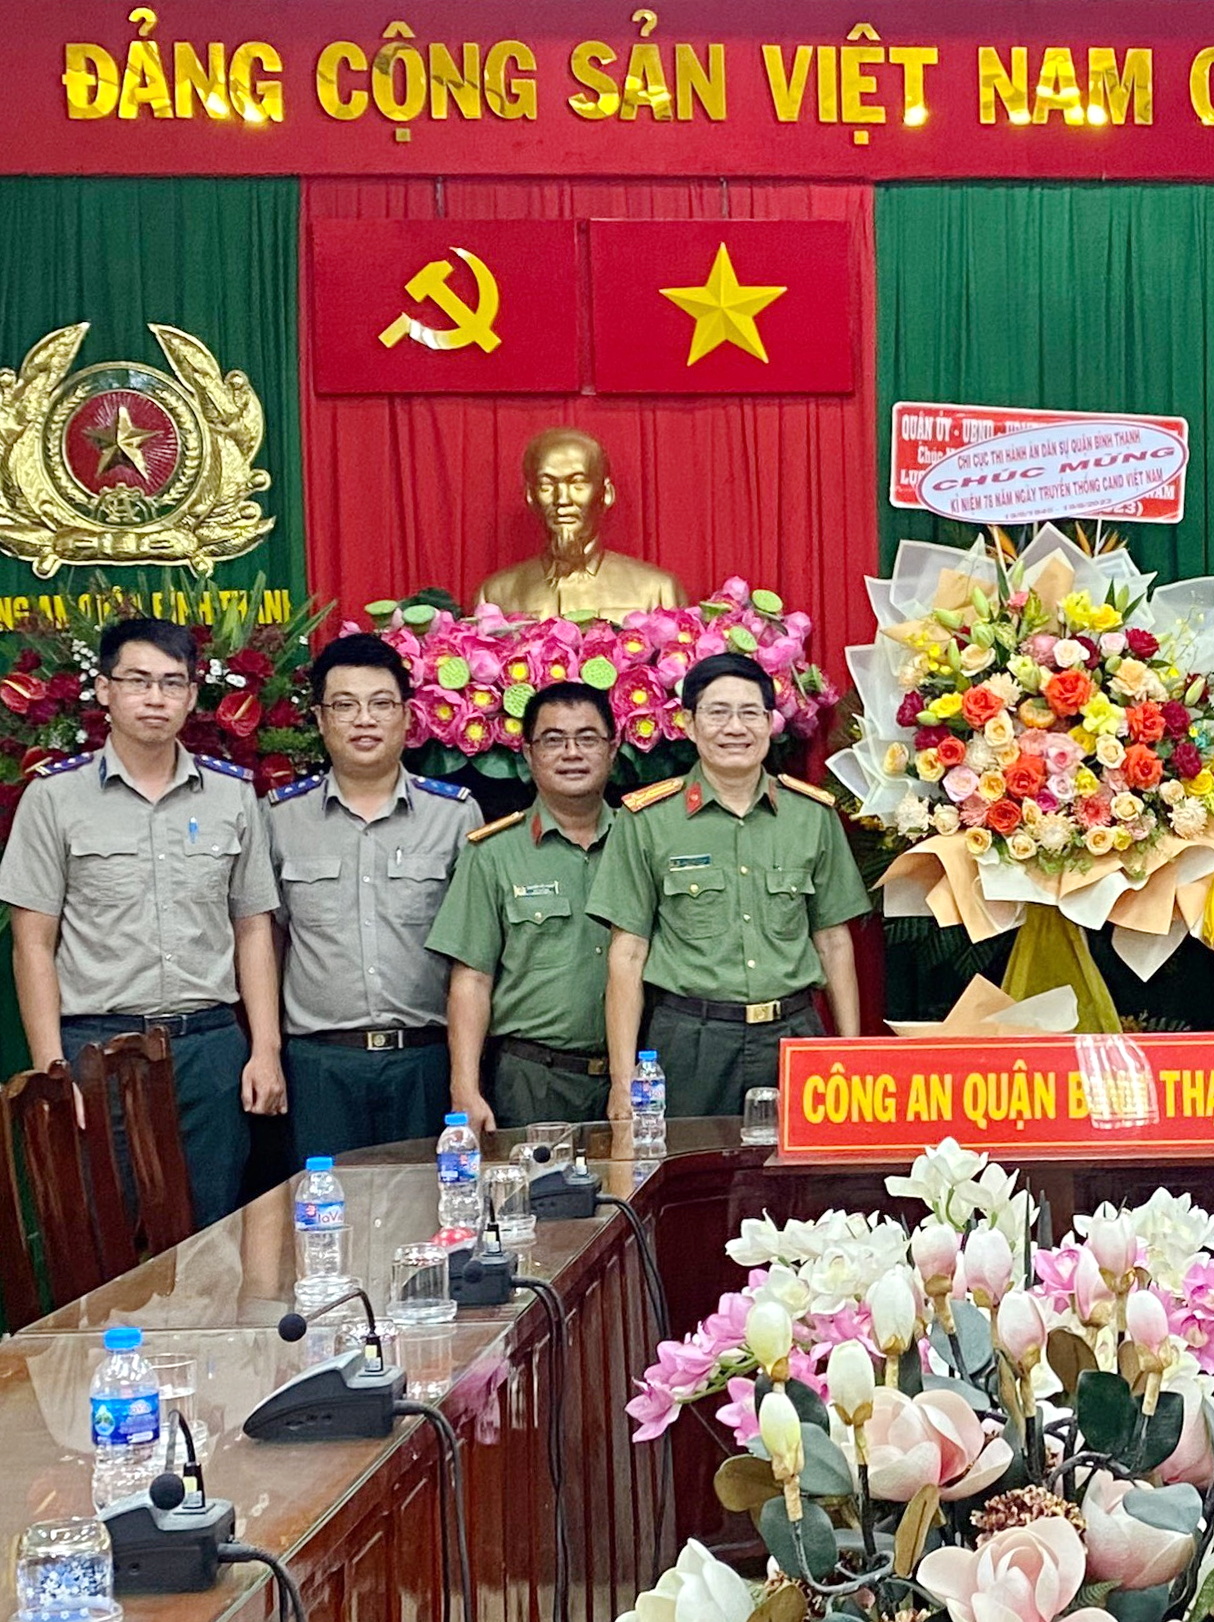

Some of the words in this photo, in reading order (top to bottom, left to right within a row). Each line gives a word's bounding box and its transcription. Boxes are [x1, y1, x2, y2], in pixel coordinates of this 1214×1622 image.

[62, 8, 283, 121] ĐẢNG
[318, 21, 536, 141] CỘNG
[568, 9, 726, 121] SẢN
[761, 23, 938, 144] VIỆT
[978, 47, 1153, 125] NAM
[1071, 433, 1093, 456] QUẬN
[1094, 430, 1114, 450] BÌNH
[1115, 429, 1141, 449] THẠNH
[932, 467, 1045, 491] CHÚC
[1059, 446, 1175, 474] MỪNG
[1073, 473, 1101, 496] THỐNG
[1126, 467, 1144, 491] VIỆT
[1145, 468, 1164, 484] NAM
[803, 1062, 896, 1123] CÔNG
[906, 1074, 954, 1120] AN
[964, 1059, 1056, 1129] QUẬN
